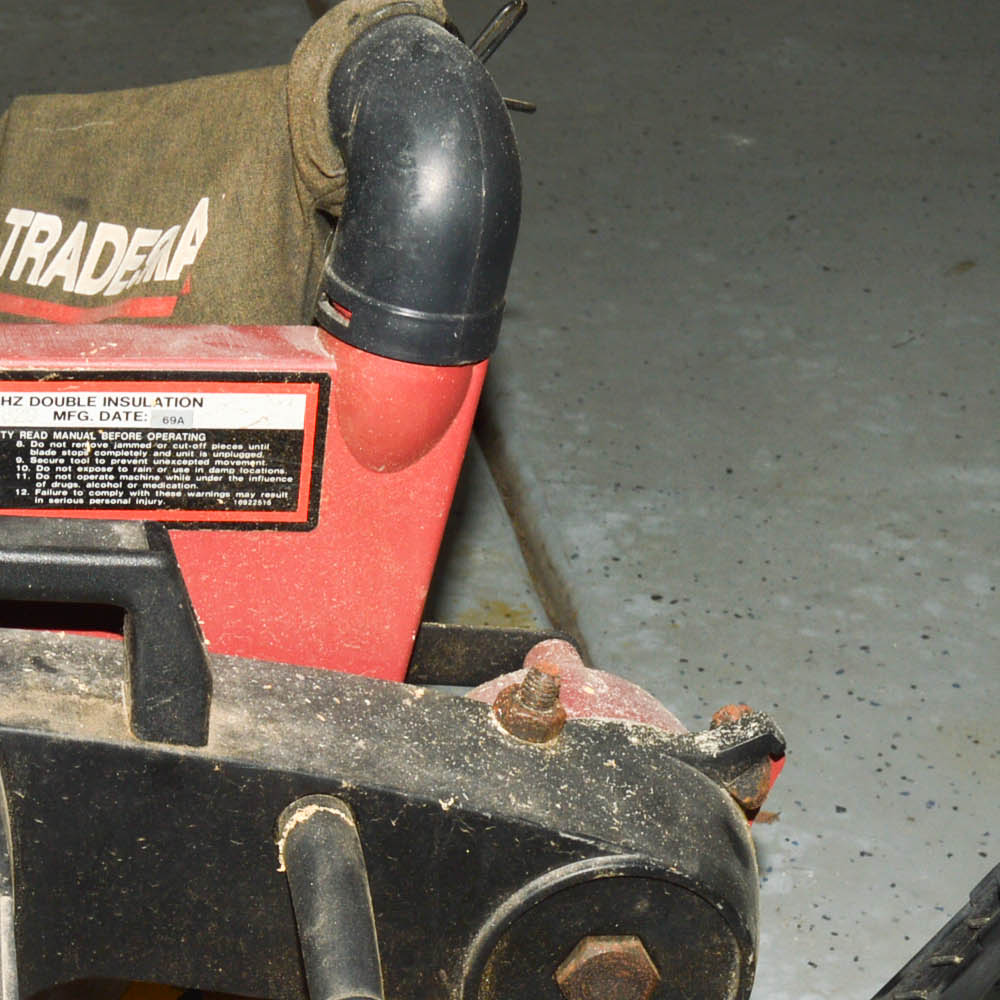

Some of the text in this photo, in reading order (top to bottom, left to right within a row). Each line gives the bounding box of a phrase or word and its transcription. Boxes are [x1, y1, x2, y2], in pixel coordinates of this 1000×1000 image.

[29, 396, 97, 407] DOUBLE
[103, 397, 204, 407] INSULATION
[53, 411, 93, 421] MFG.
[100, 411, 148, 421] DATE:
[162, 416, 184, 424] 69A
[20, 431, 48, 439] READ
[53, 432, 96, 440] MANUAL
[102, 432, 142, 440] BEFORE
[147, 433, 206, 441] OPERATING
[114, 442, 152, 450] jammed
[212, 443, 243, 451] pieces
[62, 449, 89, 457] stops
[94, 450, 147, 458] completely
[213, 451, 264, 459] unplugged.
[111, 458, 148, 466] prevent
[209, 468, 235, 476] damp
[77, 474, 114, 482] operate
[89, 490, 124, 498] comply
[188, 491, 230, 499] warnings
[89, 498, 131, 506] personal
[136, 498, 165, 506] injury.
